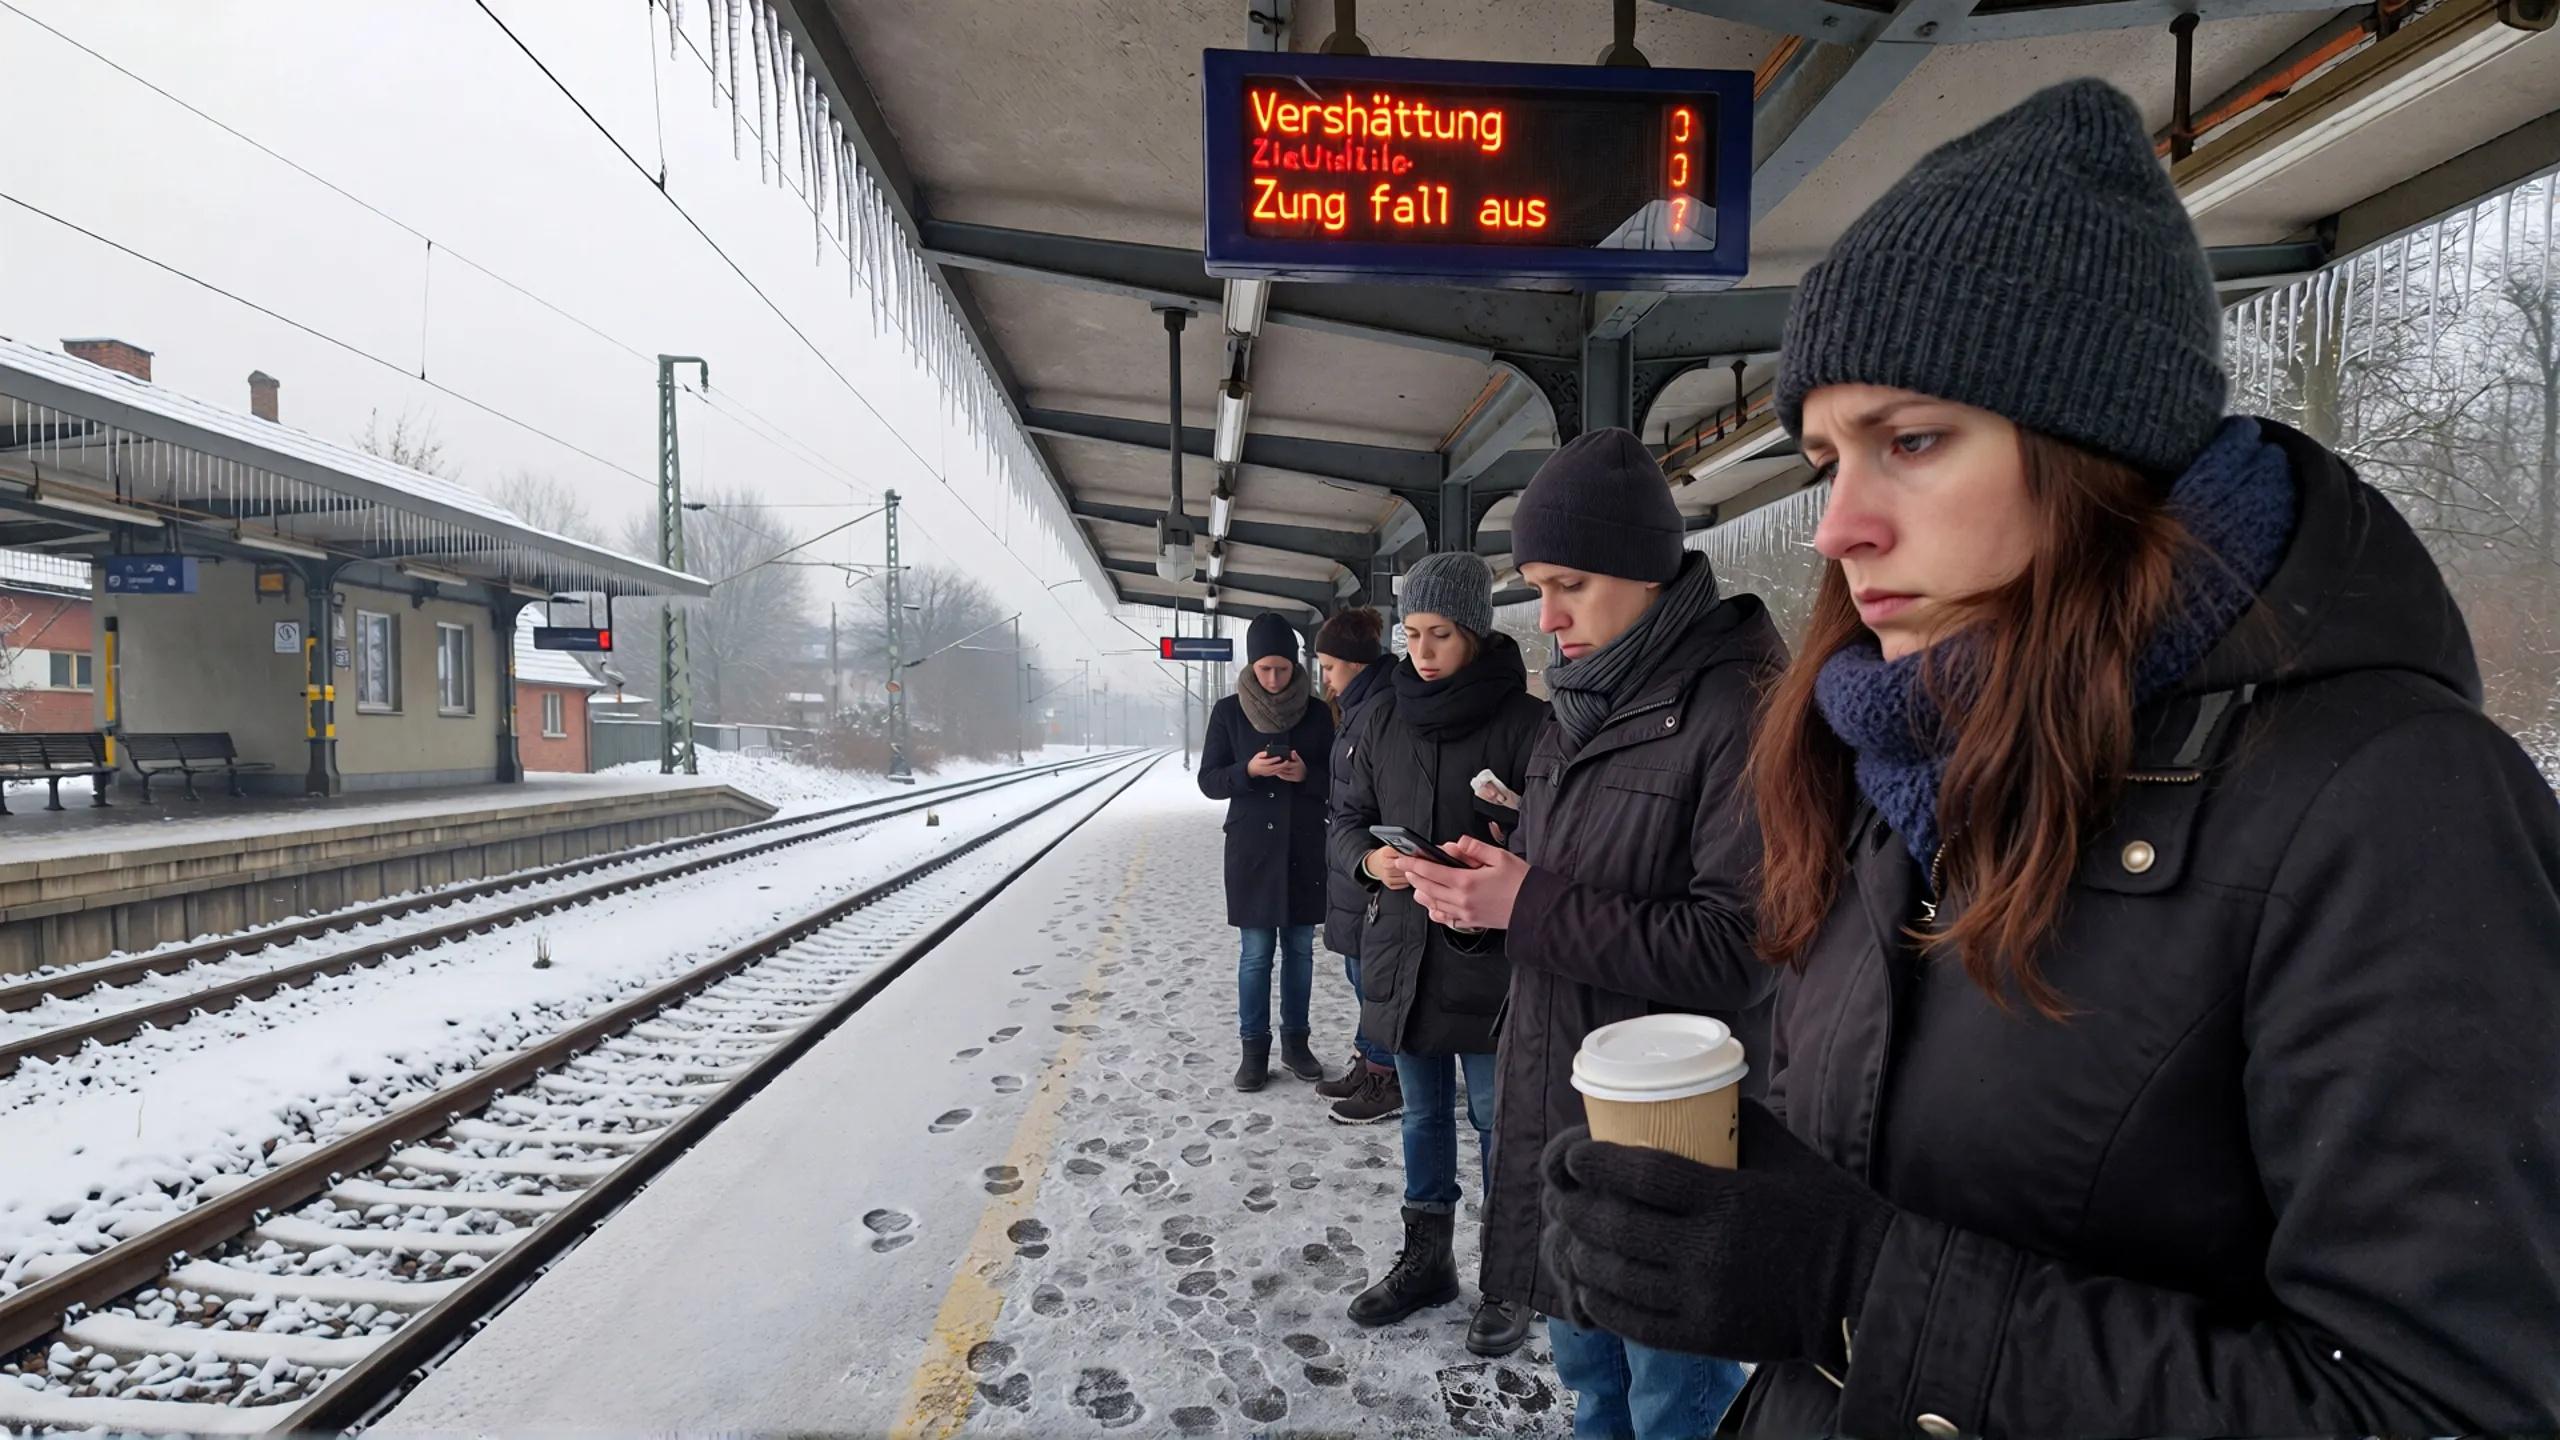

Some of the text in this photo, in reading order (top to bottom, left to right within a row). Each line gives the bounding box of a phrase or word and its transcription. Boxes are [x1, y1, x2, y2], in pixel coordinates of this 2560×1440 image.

[1251, 90, 1503, 152] Vershättung
[1252, 177, 1547, 231] Zung fall aus
